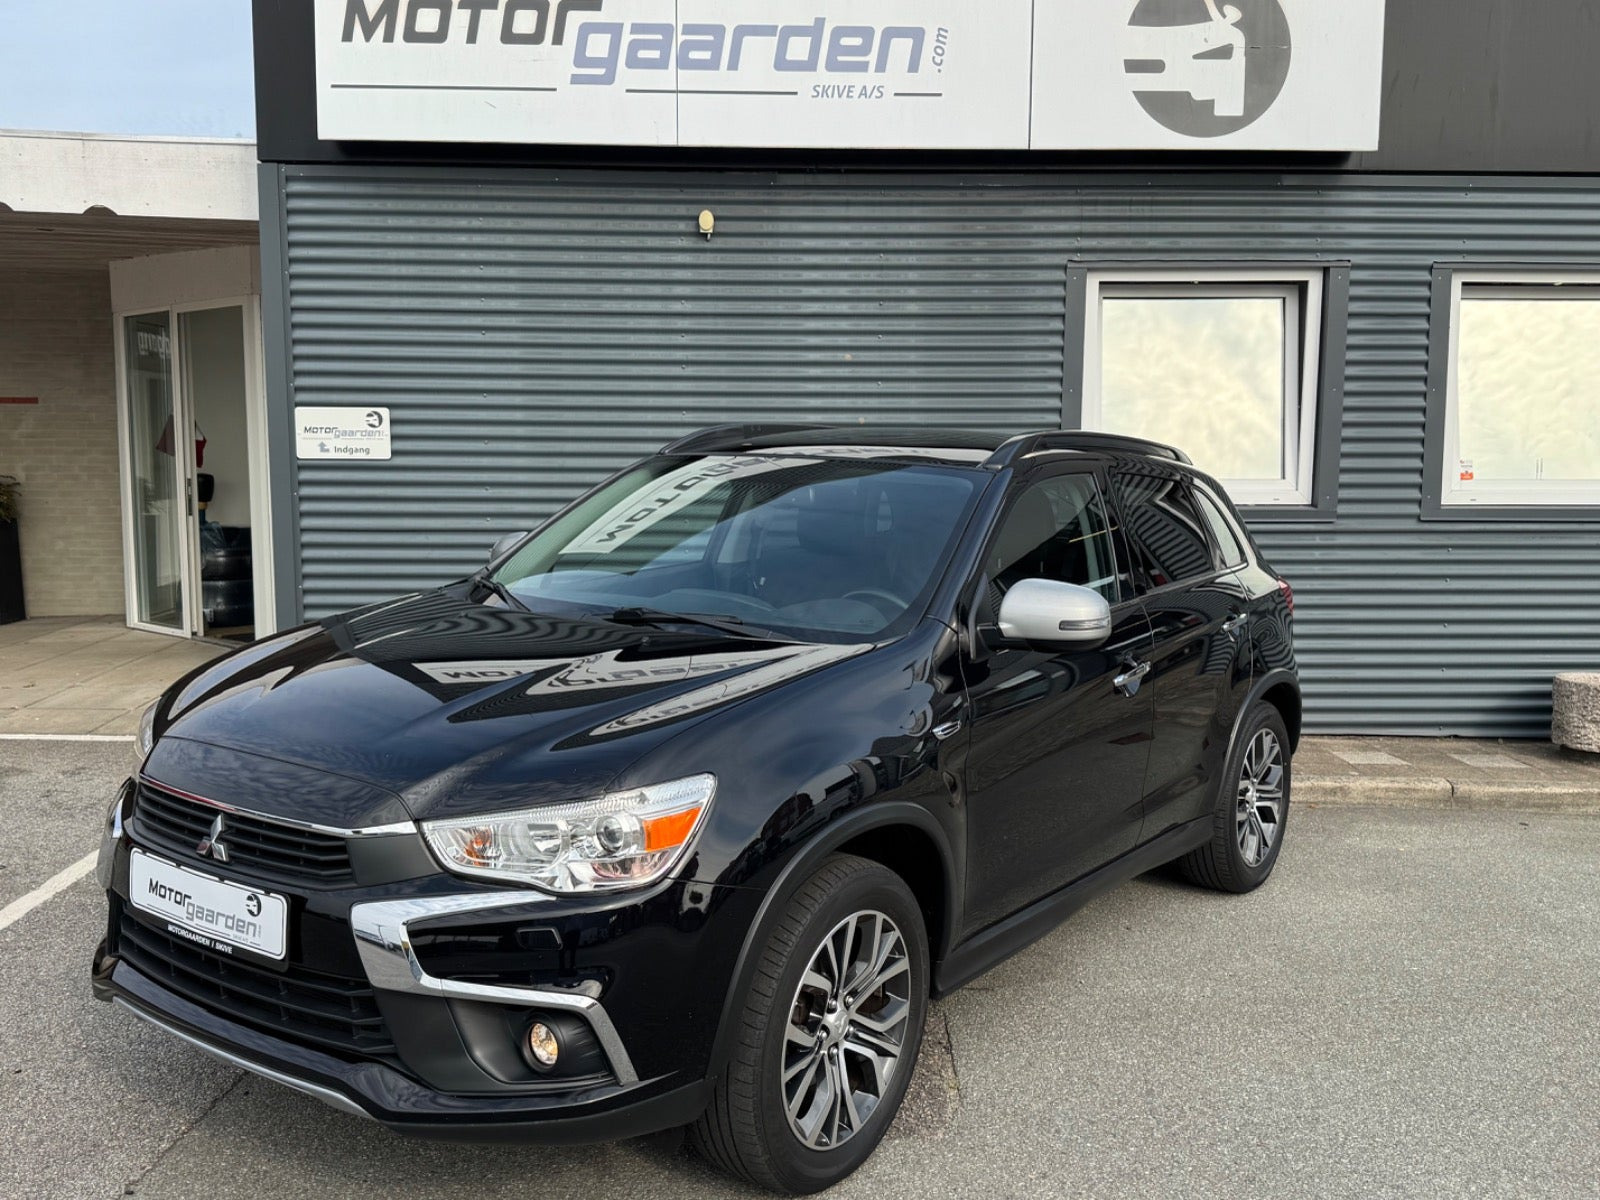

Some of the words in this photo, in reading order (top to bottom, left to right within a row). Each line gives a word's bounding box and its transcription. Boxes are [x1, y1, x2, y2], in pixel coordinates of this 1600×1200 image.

[932, 27, 949, 73] .com
[811, 84, 856, 98] SKIVE
[858, 85, 885, 99] A/S
[334, 445, 371, 455] Indgang
[215, 942, 233, 955] SKIVE
